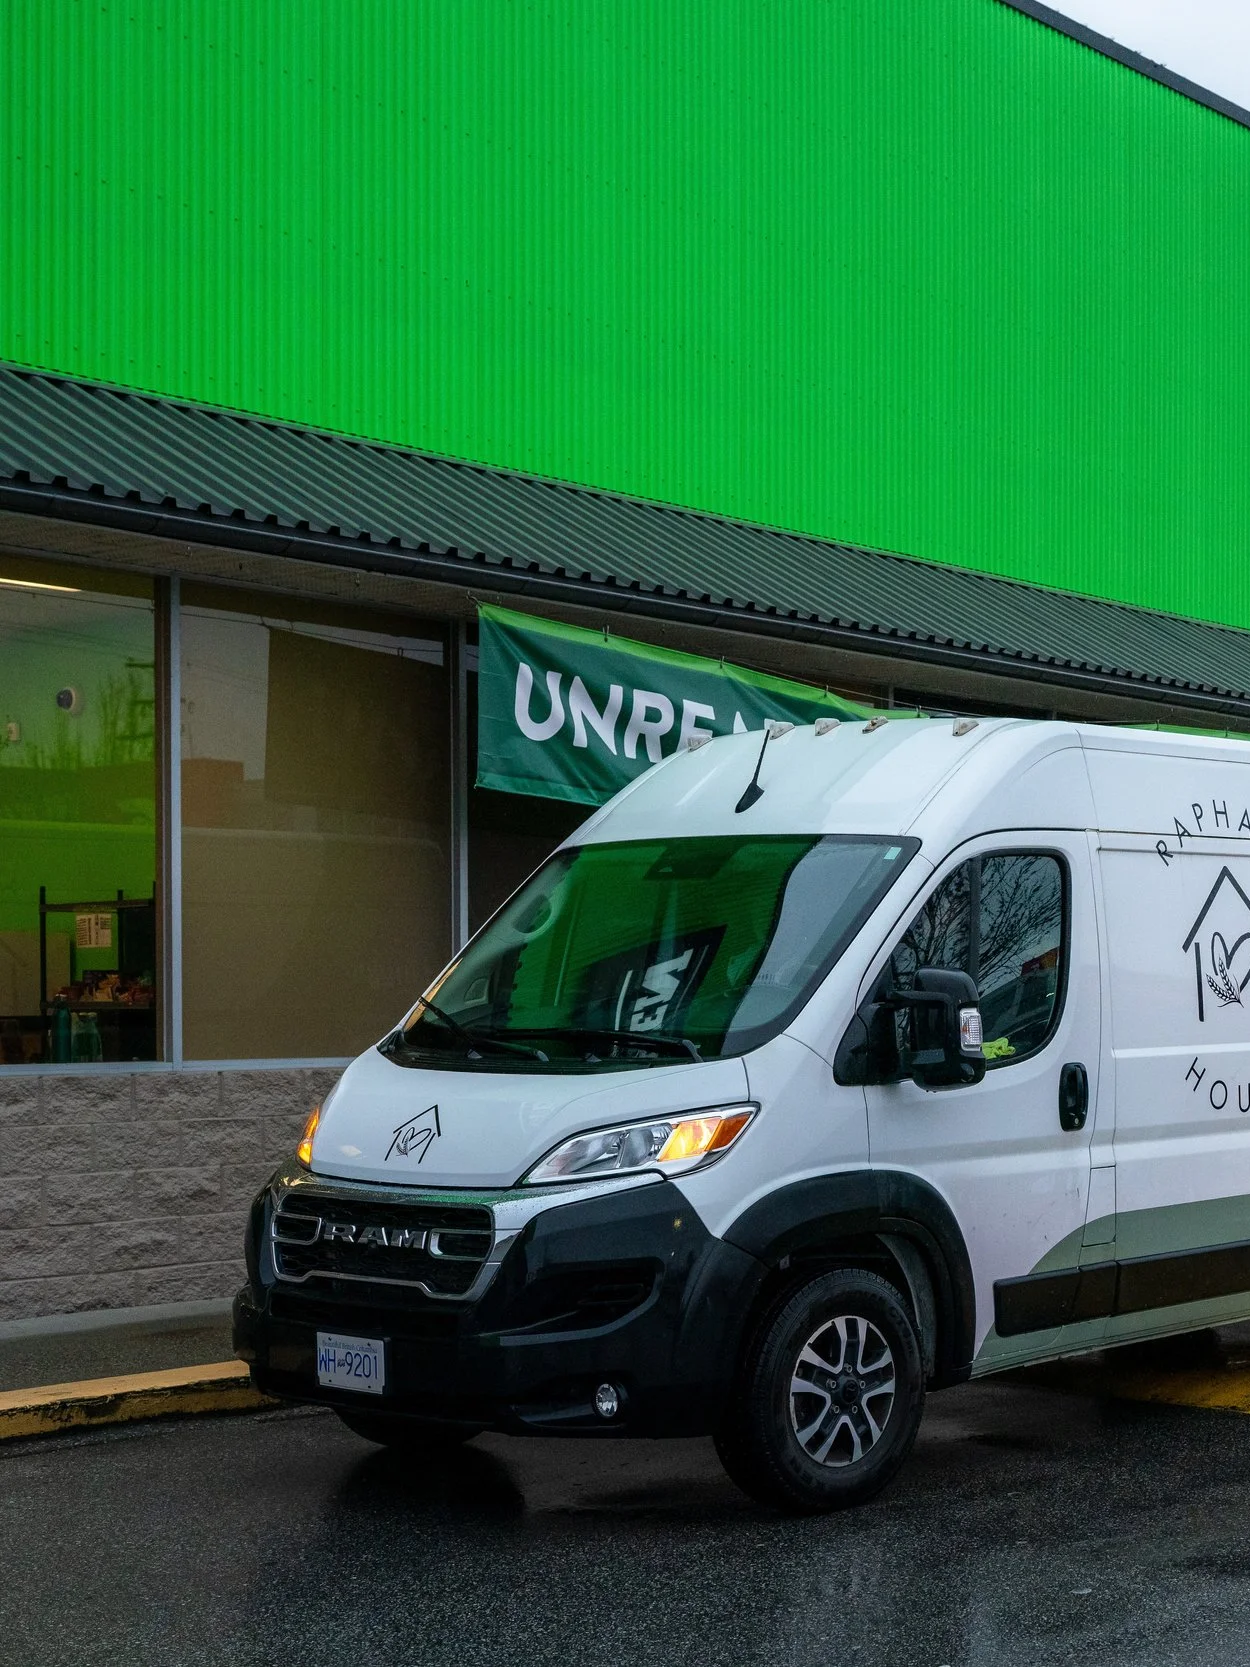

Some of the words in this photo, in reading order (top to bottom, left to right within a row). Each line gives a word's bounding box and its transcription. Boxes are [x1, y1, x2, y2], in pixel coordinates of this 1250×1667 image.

[515, 662, 775, 763] UNRE
[323, 1222, 428, 1250] RAM
[319, 1348, 337, 1373] WH
[345, 1351, 378, 1379] 9201
